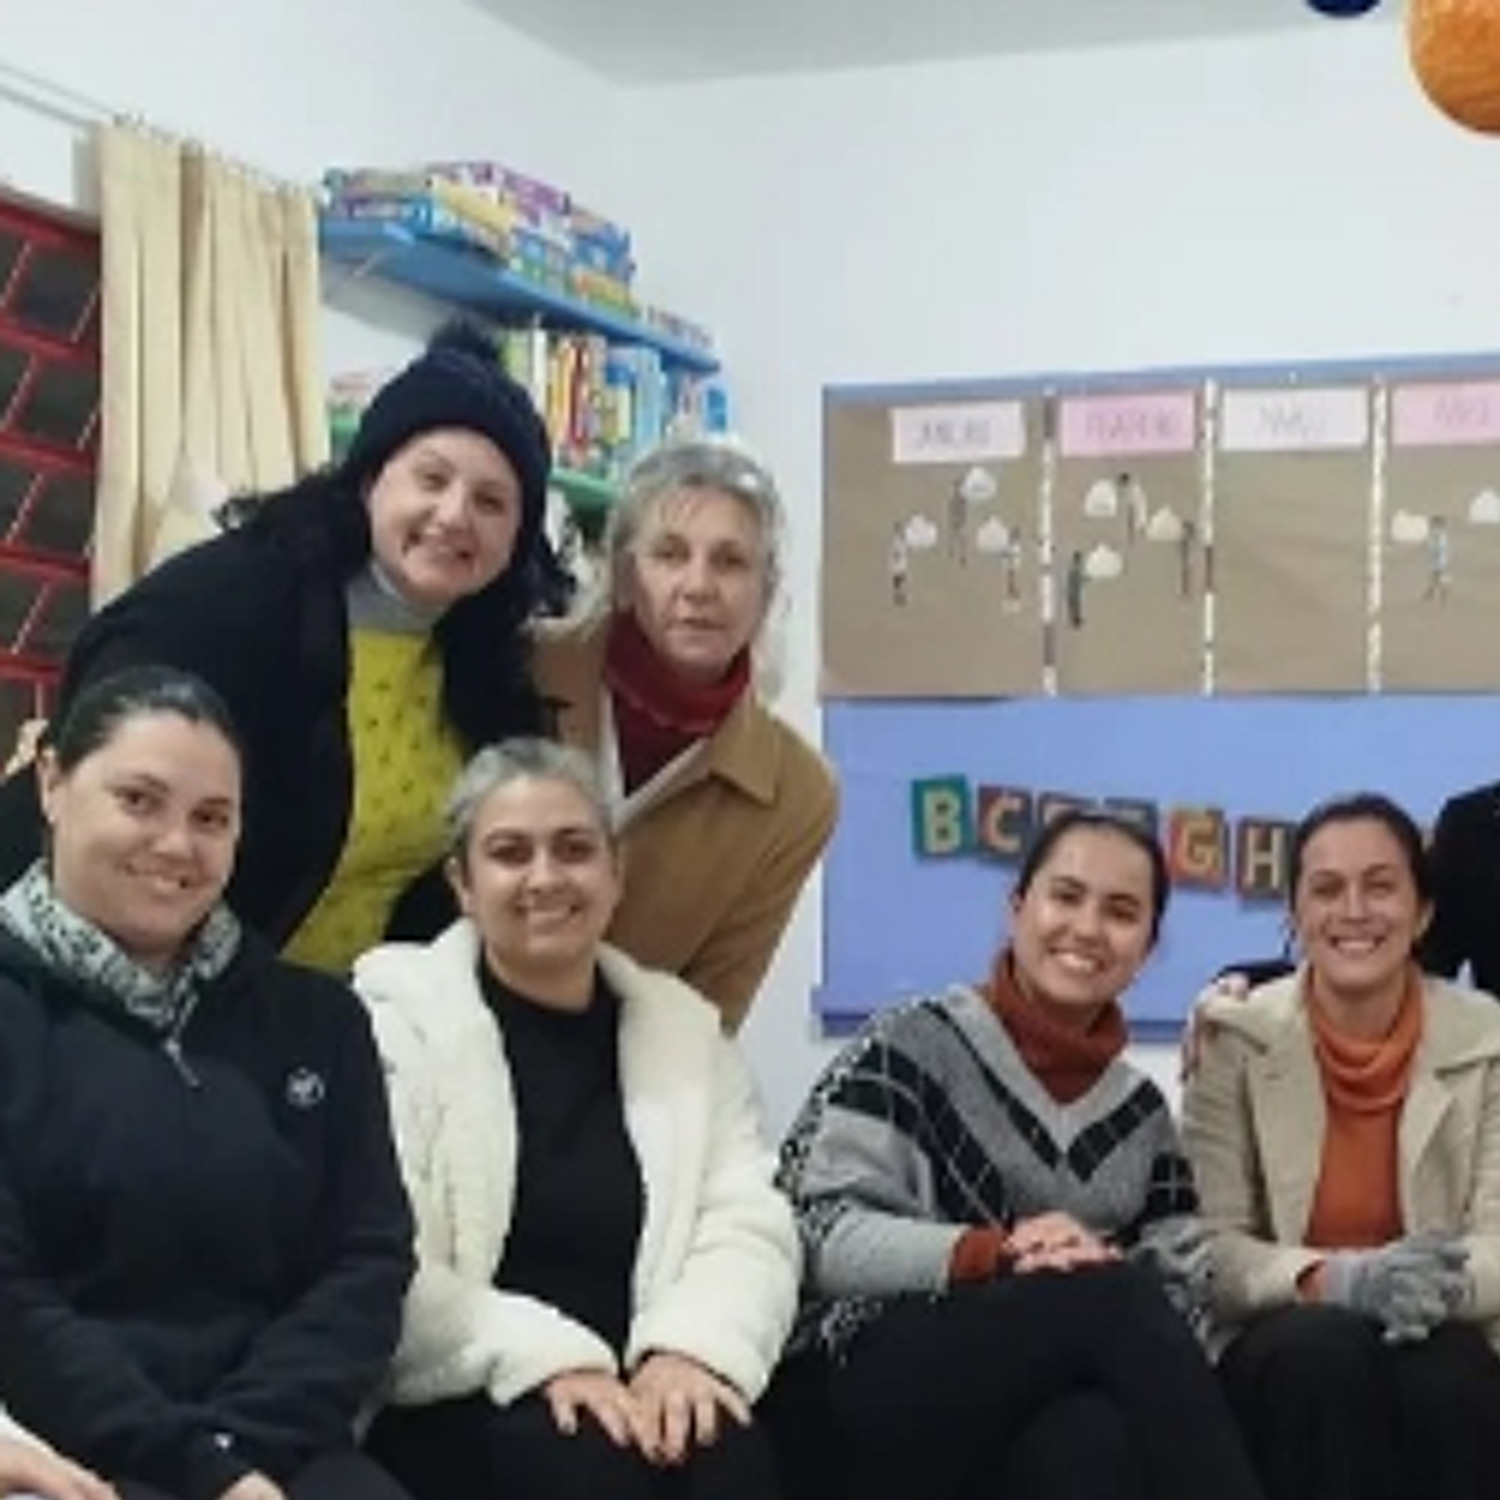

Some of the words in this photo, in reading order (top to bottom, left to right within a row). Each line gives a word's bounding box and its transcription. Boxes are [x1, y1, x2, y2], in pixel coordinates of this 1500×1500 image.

[922, 789, 962, 854] B
[993, 795, 1023, 855] C
[1182, 815, 1217, 877] G
[1244, 827, 1283, 890] H
